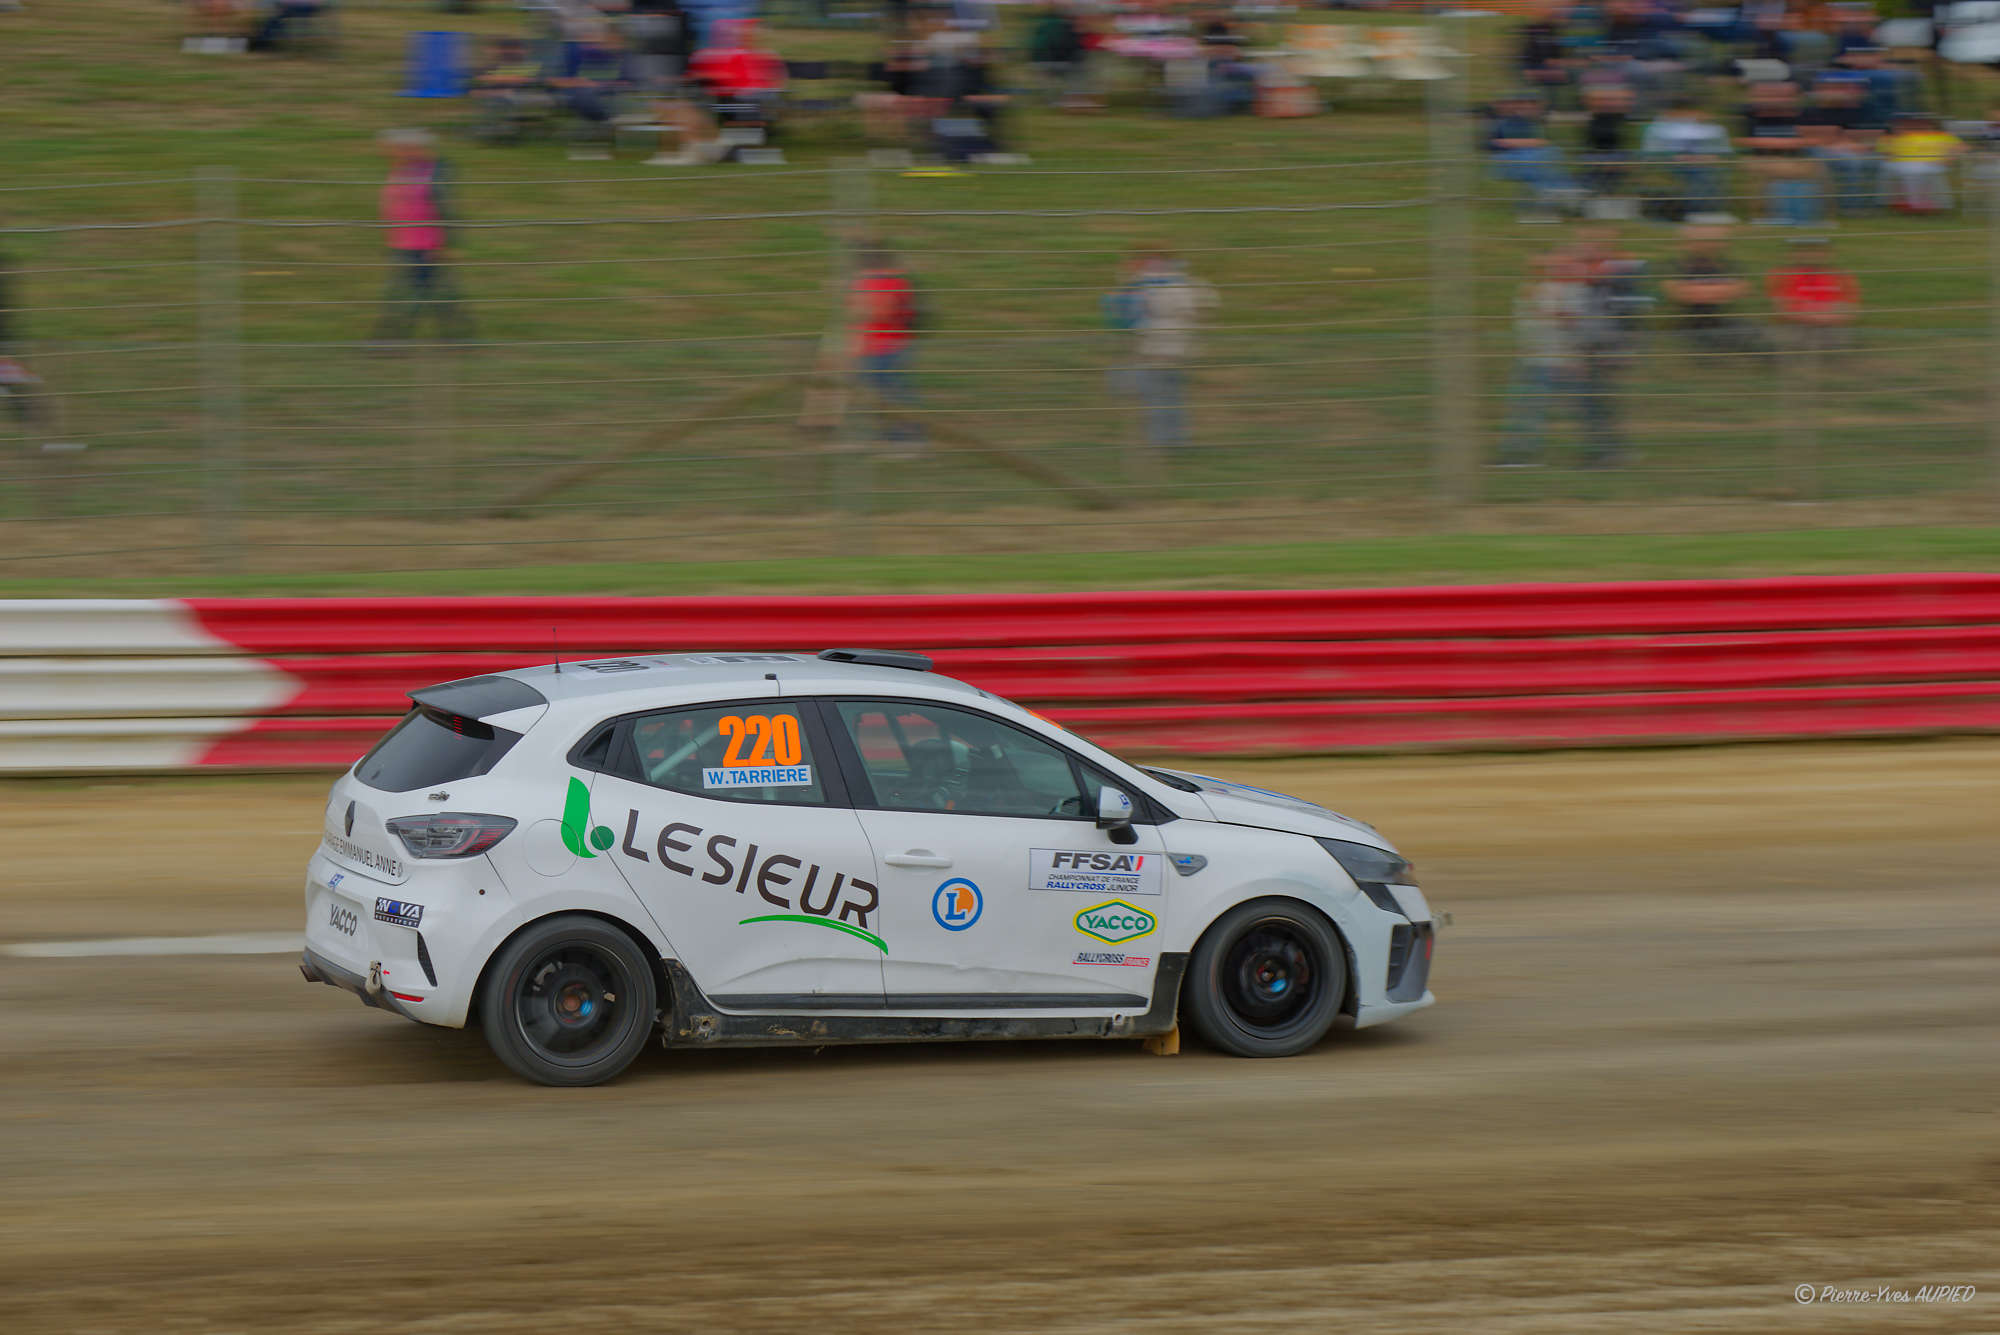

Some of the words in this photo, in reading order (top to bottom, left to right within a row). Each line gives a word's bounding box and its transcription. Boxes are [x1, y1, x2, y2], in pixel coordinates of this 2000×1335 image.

[718, 714, 802, 767] 220
[708, 768, 808, 785] W.TARRIERE
[374, 853, 397, 876] ANNE
[622, 808, 880, 929] LESIEUR
[1051, 852, 1132, 872] FFSA
[1046, 881, 1106, 891] RALLYCROSS
[1106, 884, 1139, 892] JUNIOR
[1048, 873, 1100, 882] CHAMPIONNAT
[1112, 876, 1140, 884] FRANCE
[330, 903, 358, 936] YACCO
[1084, 915, 1148, 931] YACCO
[1077, 952, 1126, 964] RALLYCROSS
